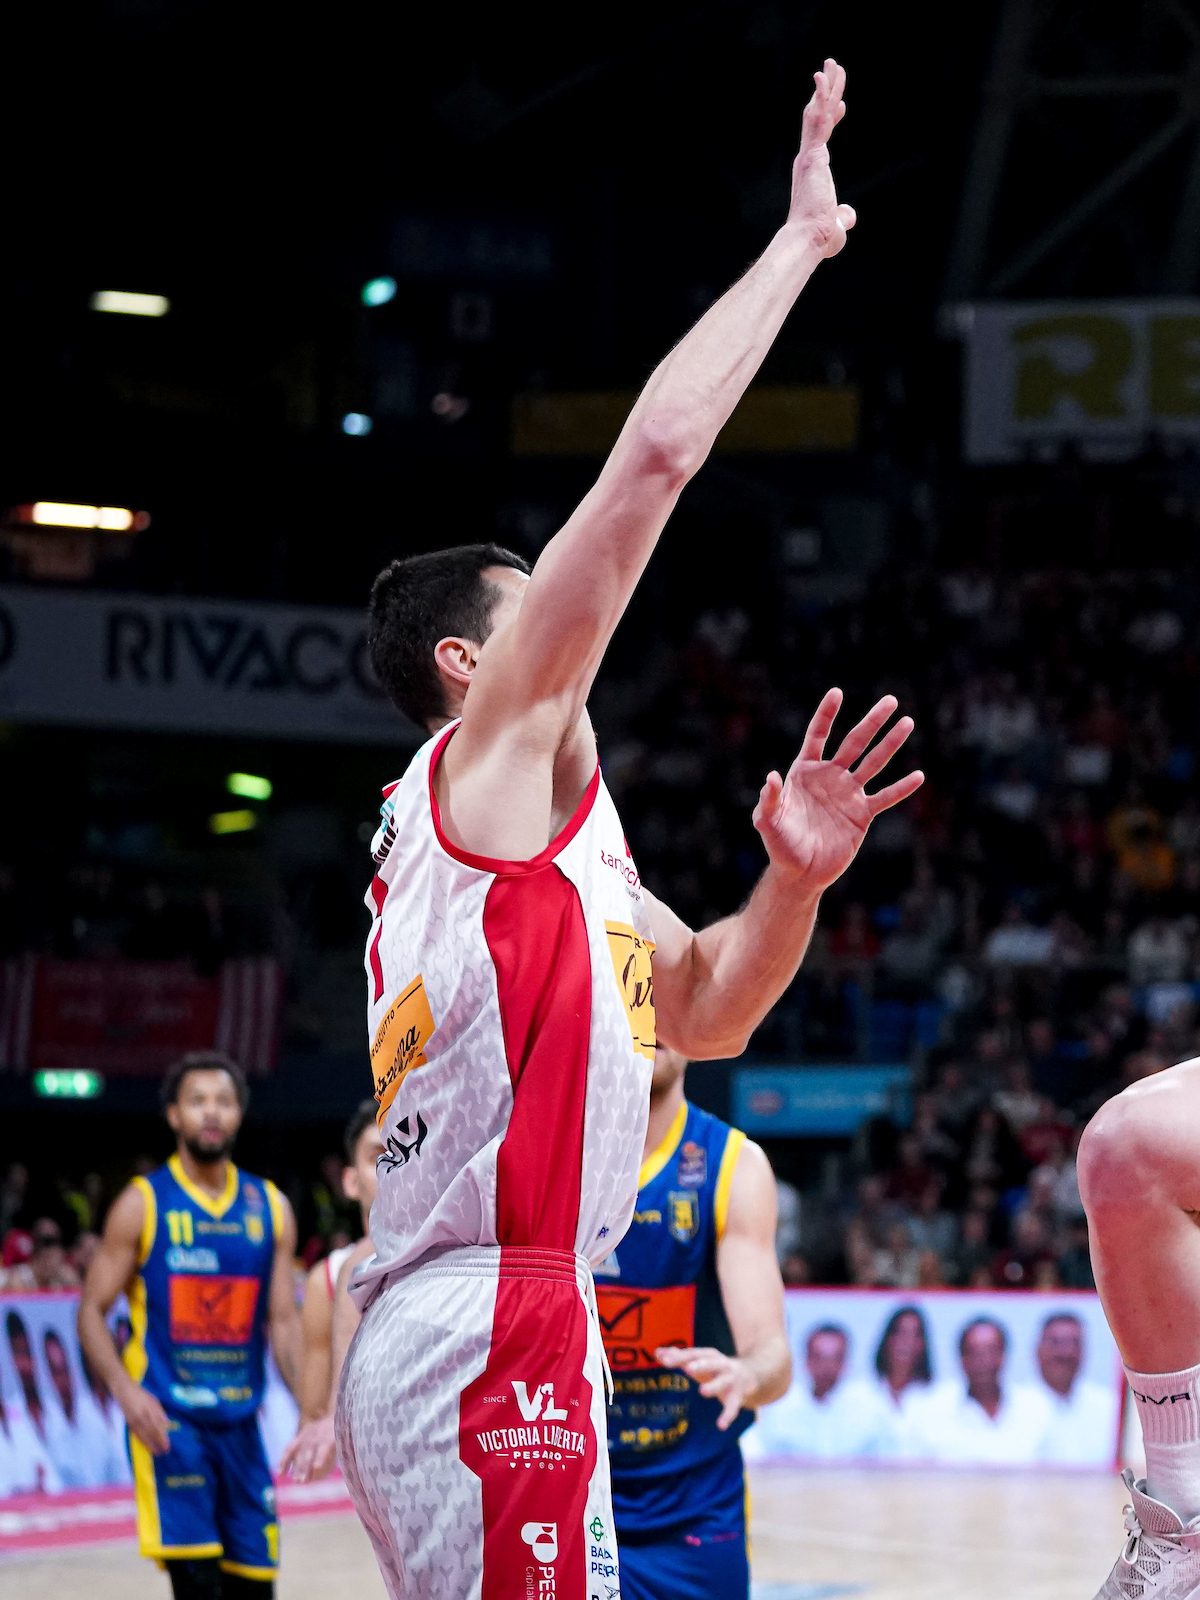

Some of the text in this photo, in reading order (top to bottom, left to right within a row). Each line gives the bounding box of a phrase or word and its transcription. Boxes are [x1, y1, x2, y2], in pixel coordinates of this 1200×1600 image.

[166, 1210, 194, 1246] 11
[483, 1396, 507, 1404] SINCE
[511, 1380, 568, 1422] VL
[476, 1425, 587, 1456] VICTORIA LIBERTA
[513, 1450, 562, 1461] PESARO
